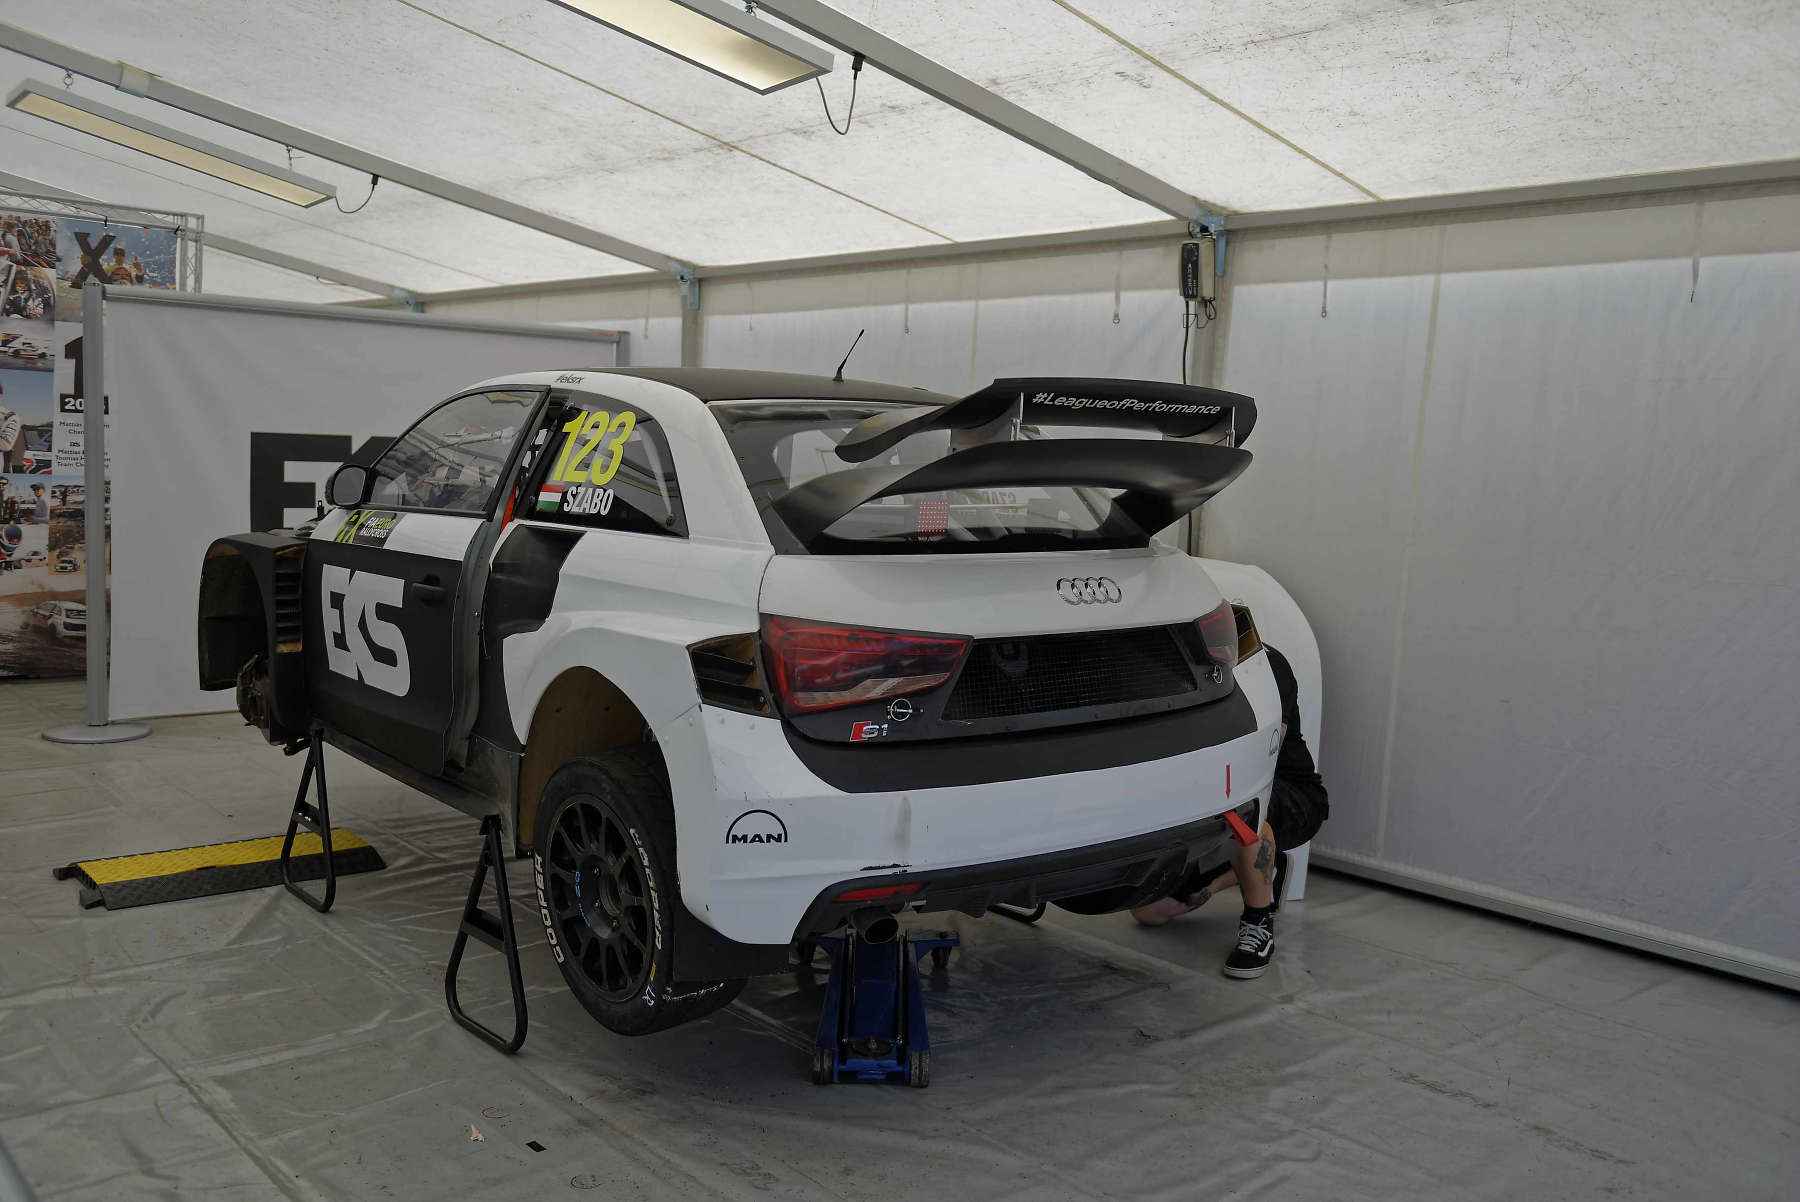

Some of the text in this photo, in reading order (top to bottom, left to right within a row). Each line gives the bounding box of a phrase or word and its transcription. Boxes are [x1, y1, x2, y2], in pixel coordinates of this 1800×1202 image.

[1032, 392, 1221, 414] #LeagueofPerformance
[552, 410, 637, 486] 123
[563, 486, 614, 516] SZABO
[321, 563, 411, 697] EKS
[731, 833, 783, 844] MAN
[534, 852, 565, 964] COOPER
